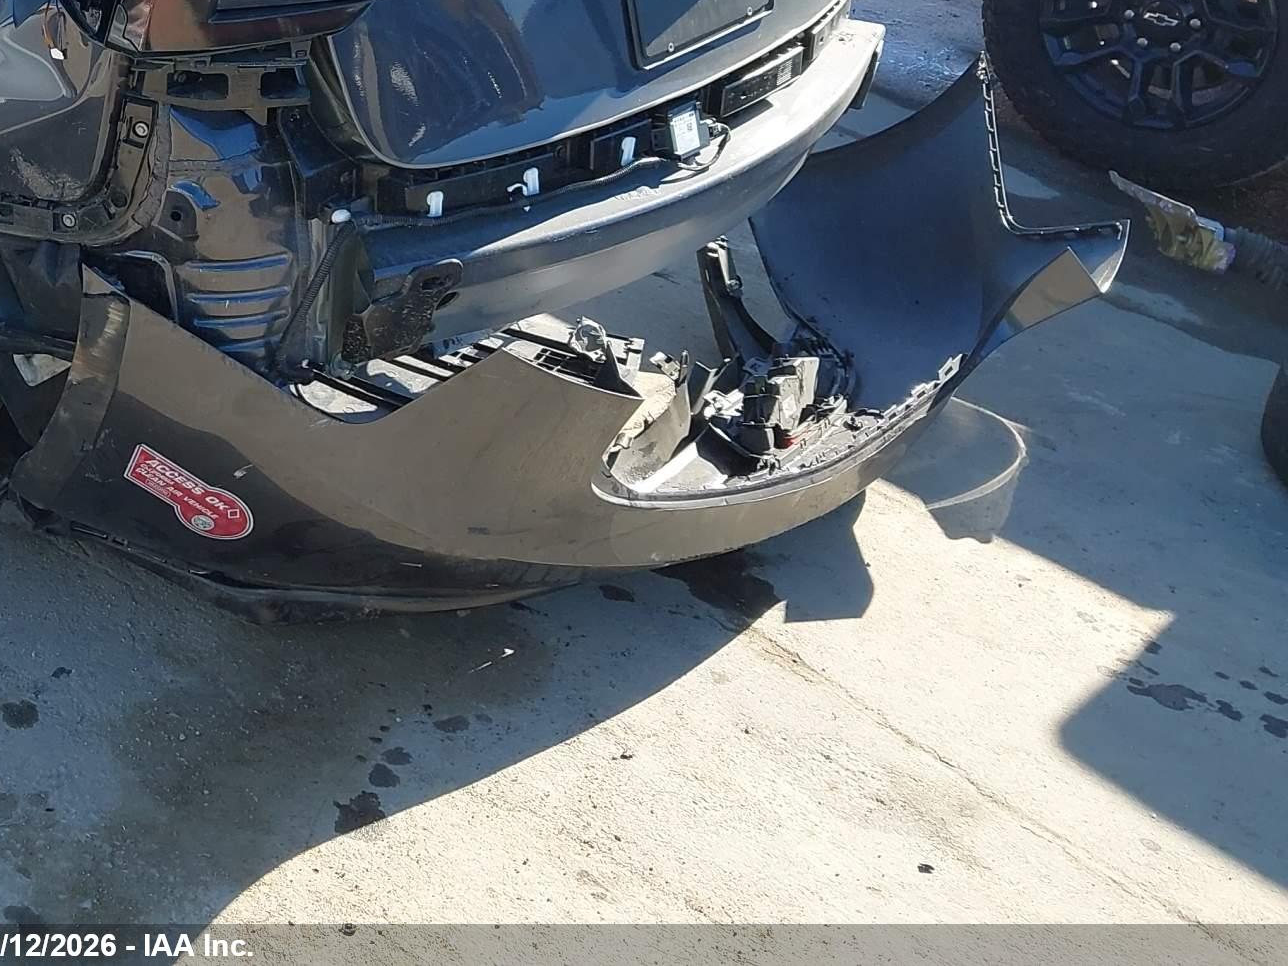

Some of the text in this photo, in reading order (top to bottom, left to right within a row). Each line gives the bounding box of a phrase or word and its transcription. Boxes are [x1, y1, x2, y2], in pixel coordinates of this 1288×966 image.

[135, 468, 167, 487] CLEAN
[167, 486, 183, 497] AIR
[183, 496, 219, 520] VEHICLE
[145, 459, 205, 495] ACCESS
[205, 496, 229, 511] OK
